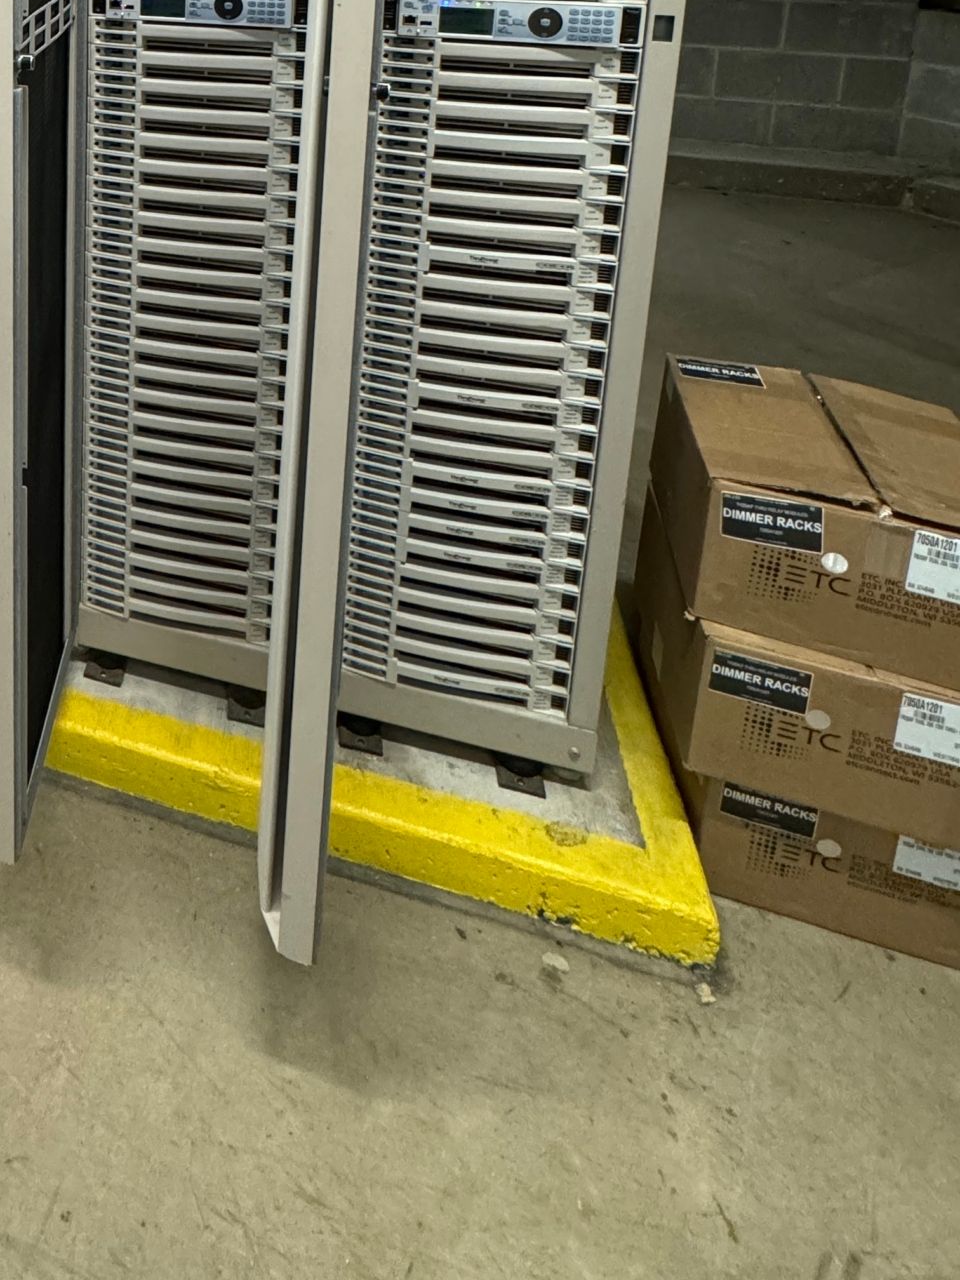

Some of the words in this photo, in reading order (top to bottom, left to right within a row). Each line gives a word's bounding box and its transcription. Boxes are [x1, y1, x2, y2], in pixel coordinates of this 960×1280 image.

[678, 362, 720, 374] DIMMER
[721, 369, 761, 379] RACKS
[723, 507, 773, 526] DIMMER
[776, 516, 822, 534] RACKS
[785, 563, 851, 596] ETC
[880, 592, 901, 604] BOX
[712, 663, 762, 686] DIMMER
[764, 677, 809, 698] RACKS
[778, 720, 842, 754] ETC
[723, 787, 772, 810] DIMMER
[774, 802, 817, 822] RACKS
